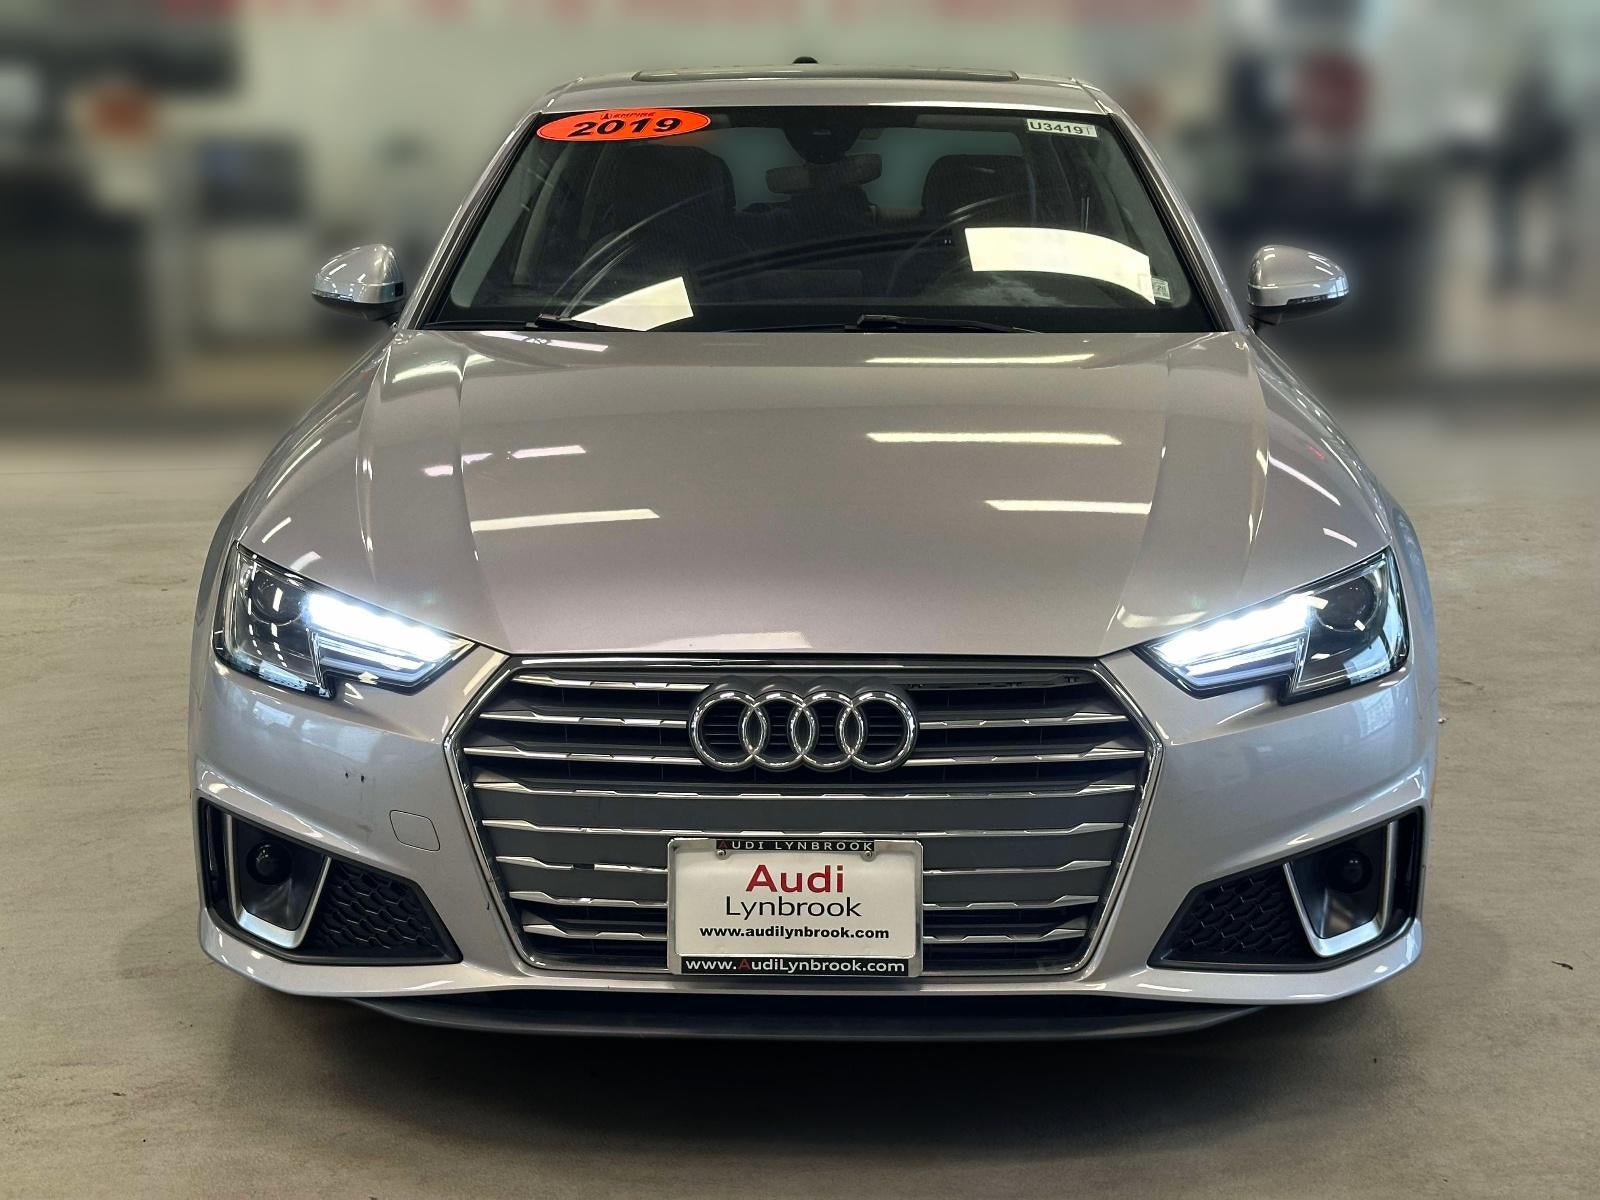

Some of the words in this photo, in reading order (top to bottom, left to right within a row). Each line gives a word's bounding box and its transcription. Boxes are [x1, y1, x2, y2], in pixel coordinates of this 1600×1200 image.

[567, 118, 682, 138] 2019
[718, 840, 764, 850] AUDI
[775, 841, 874, 851] LYNBROOK
[746, 864, 844, 893] Audi
[726, 896, 862, 920] Lynbrook
[700, 926, 889, 939] www.audilynbrook.com
[686, 958, 905, 974] www.AudiLynbrook.com
